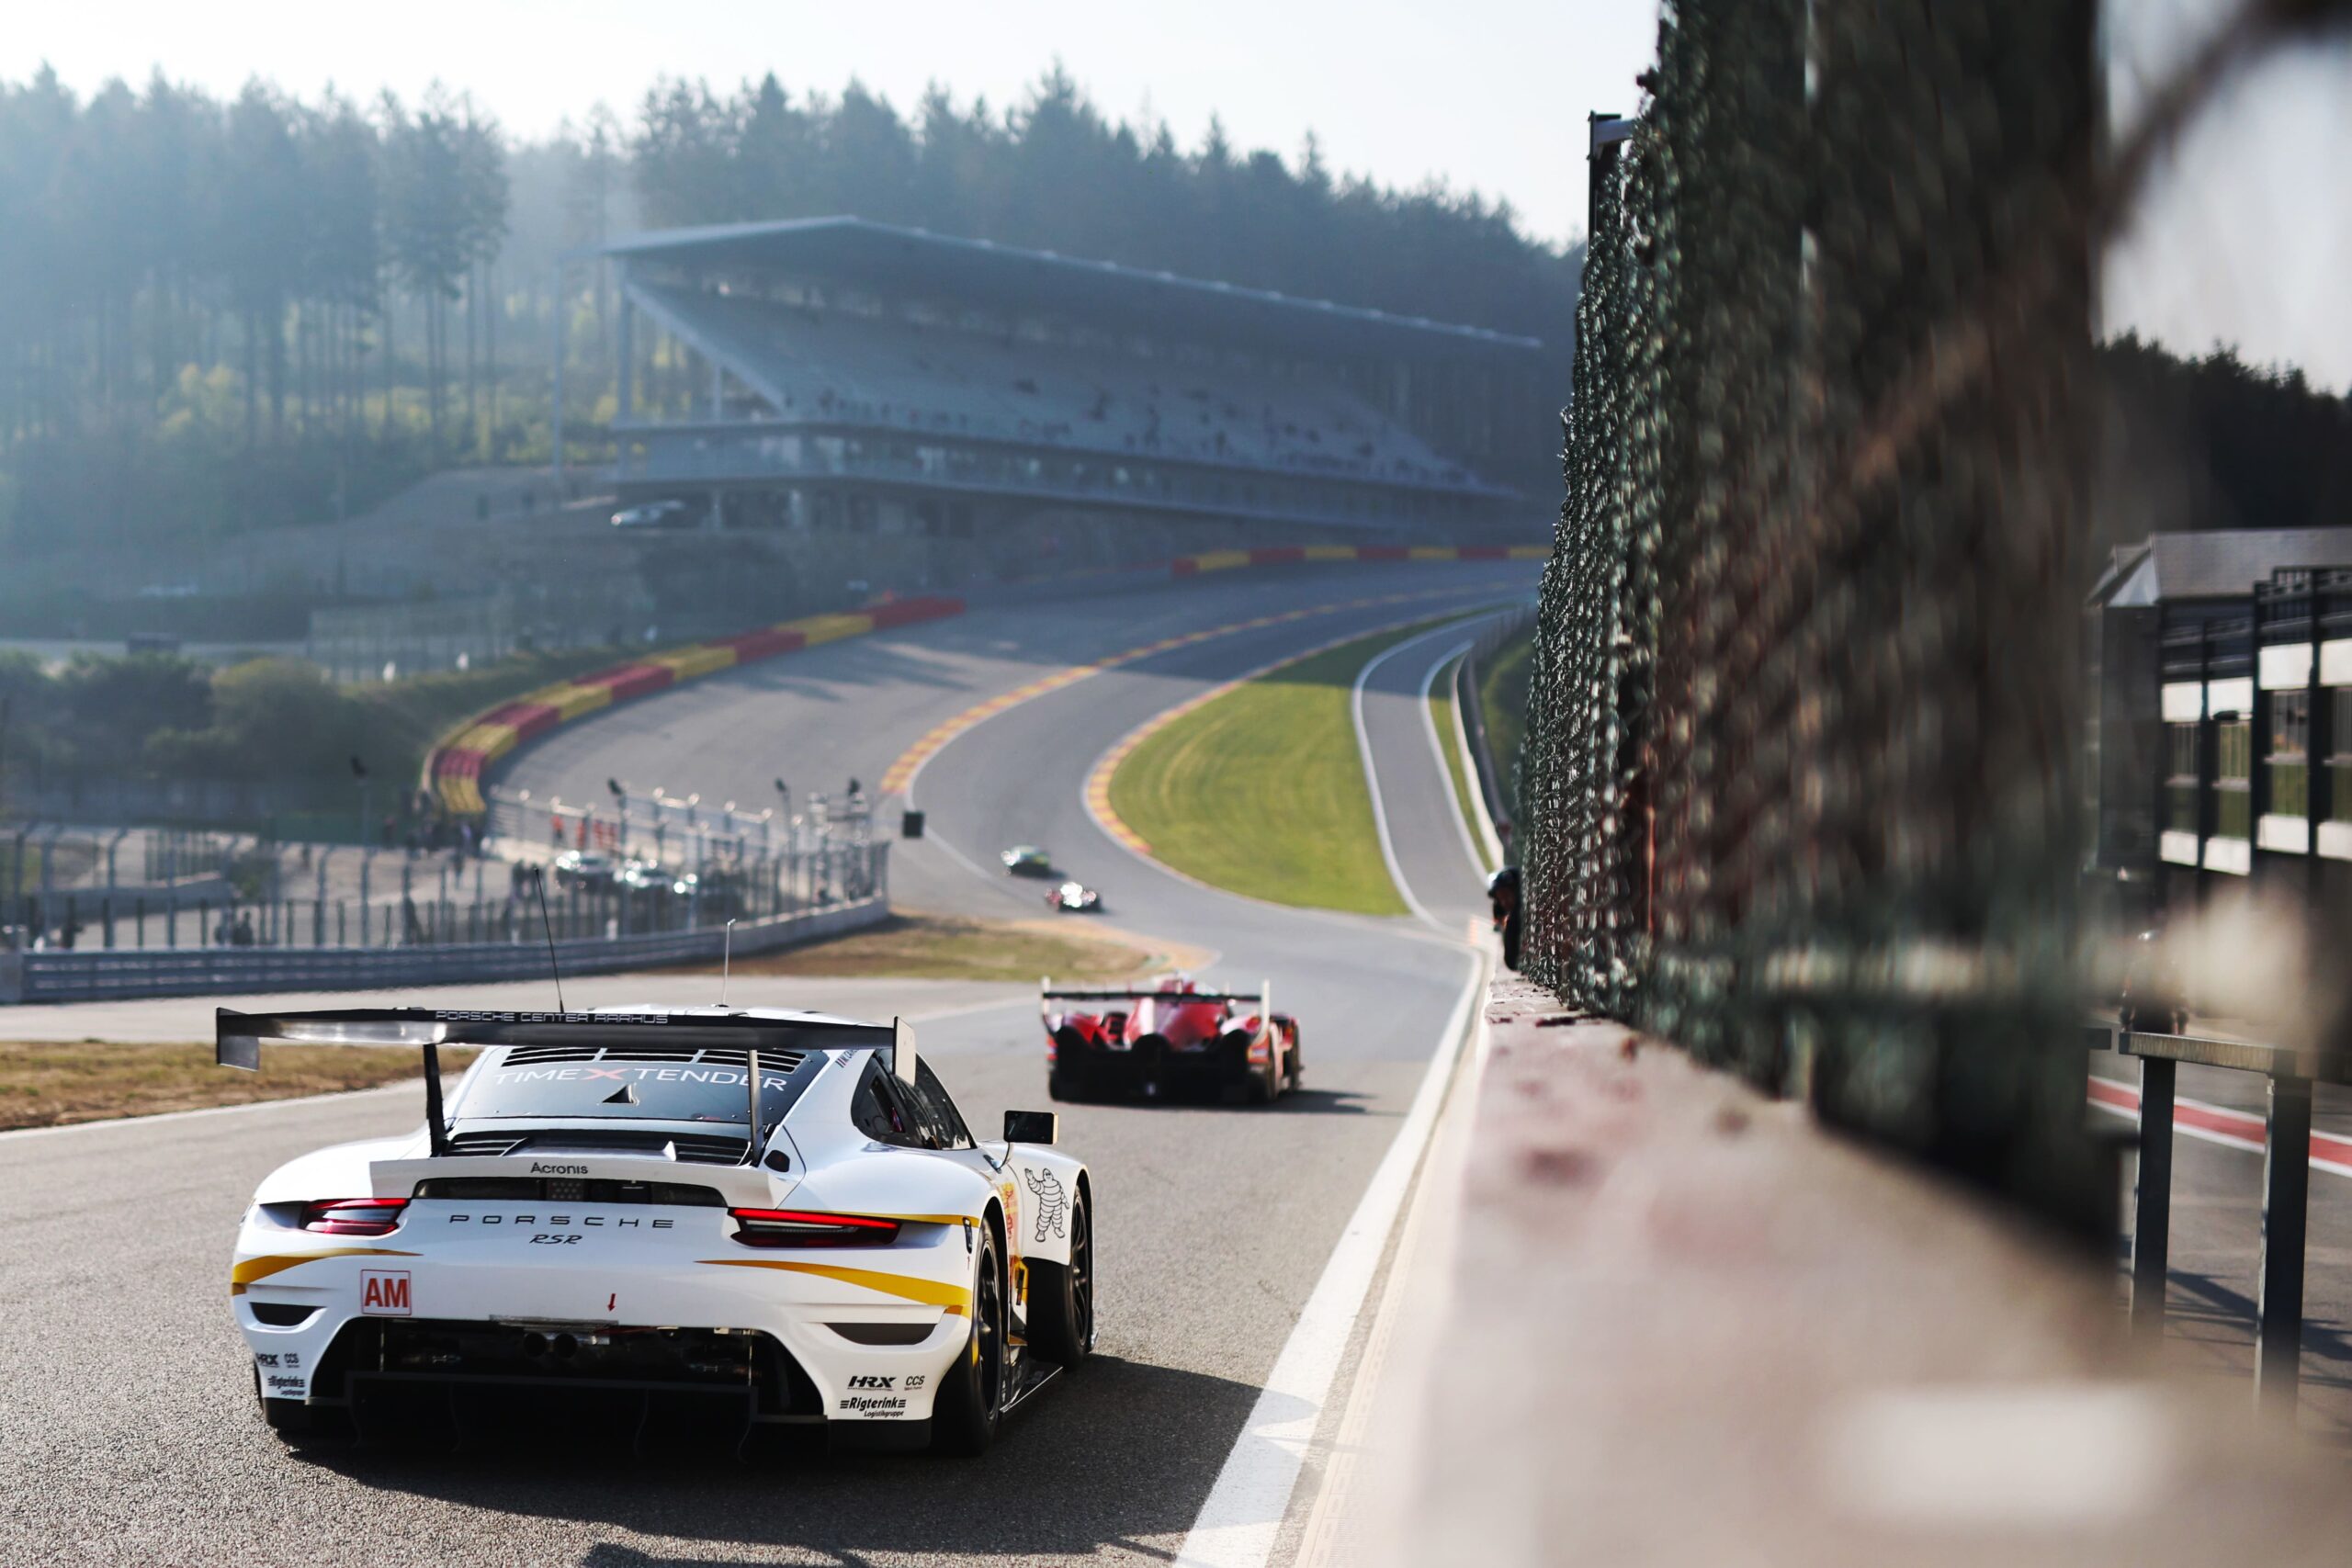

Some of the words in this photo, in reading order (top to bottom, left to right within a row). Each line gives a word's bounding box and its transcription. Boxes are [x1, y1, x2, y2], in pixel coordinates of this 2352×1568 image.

[435, 1010, 514, 1021] PORSCHE
[520, 1012, 588, 1022] CENTER
[530, 1161, 589, 1175] Acronis
[449, 1214, 674, 1229] PORSCHE
[529, 1234, 583, 1245] RSR
[364, 1278, 410, 1309] AM
[848, 1376, 897, 1387] HRX
[905, 1375, 925, 1385] CCS
[849, 1397, 898, 1411] Rigterink
